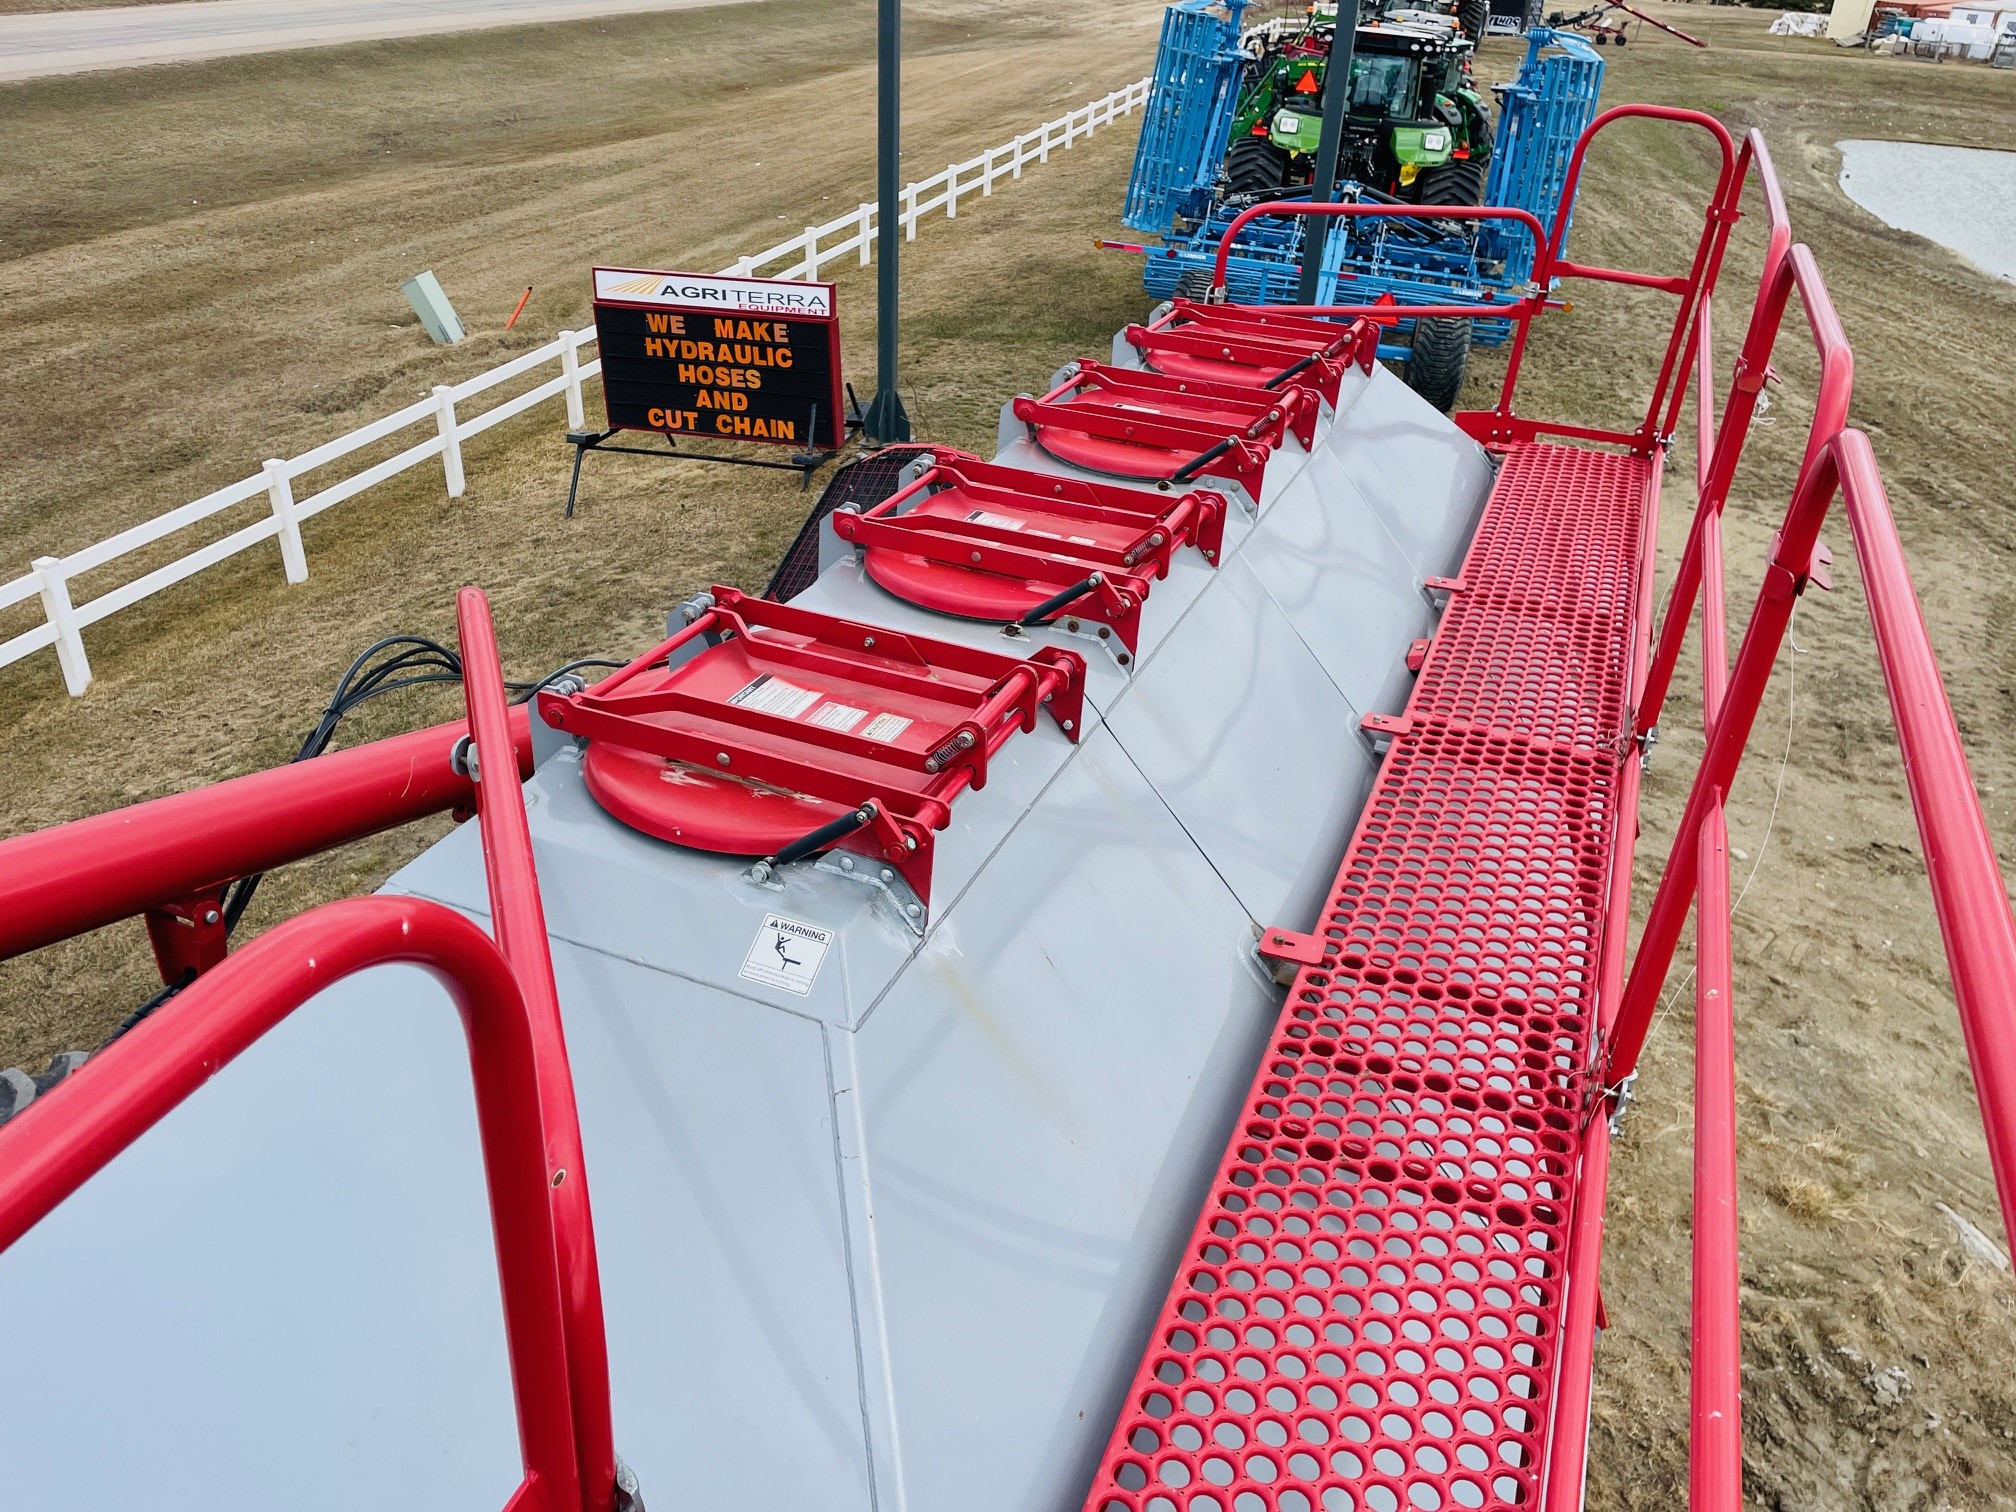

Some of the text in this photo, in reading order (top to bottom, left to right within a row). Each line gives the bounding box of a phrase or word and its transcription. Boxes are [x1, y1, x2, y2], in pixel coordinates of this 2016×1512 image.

[661, 285, 826, 308] AGRITERRA
[738, 303, 827, 315] EQUIPMENT
[646, 313, 789, 343] WE MAKE
[645, 337, 793, 368] HYDRAULIC
[678, 363, 762, 389] HOSES
[696, 389, 748, 411] AND
[647, 407, 795, 440] CUT CHAIN
[780, 921, 826, 941] WARNING
